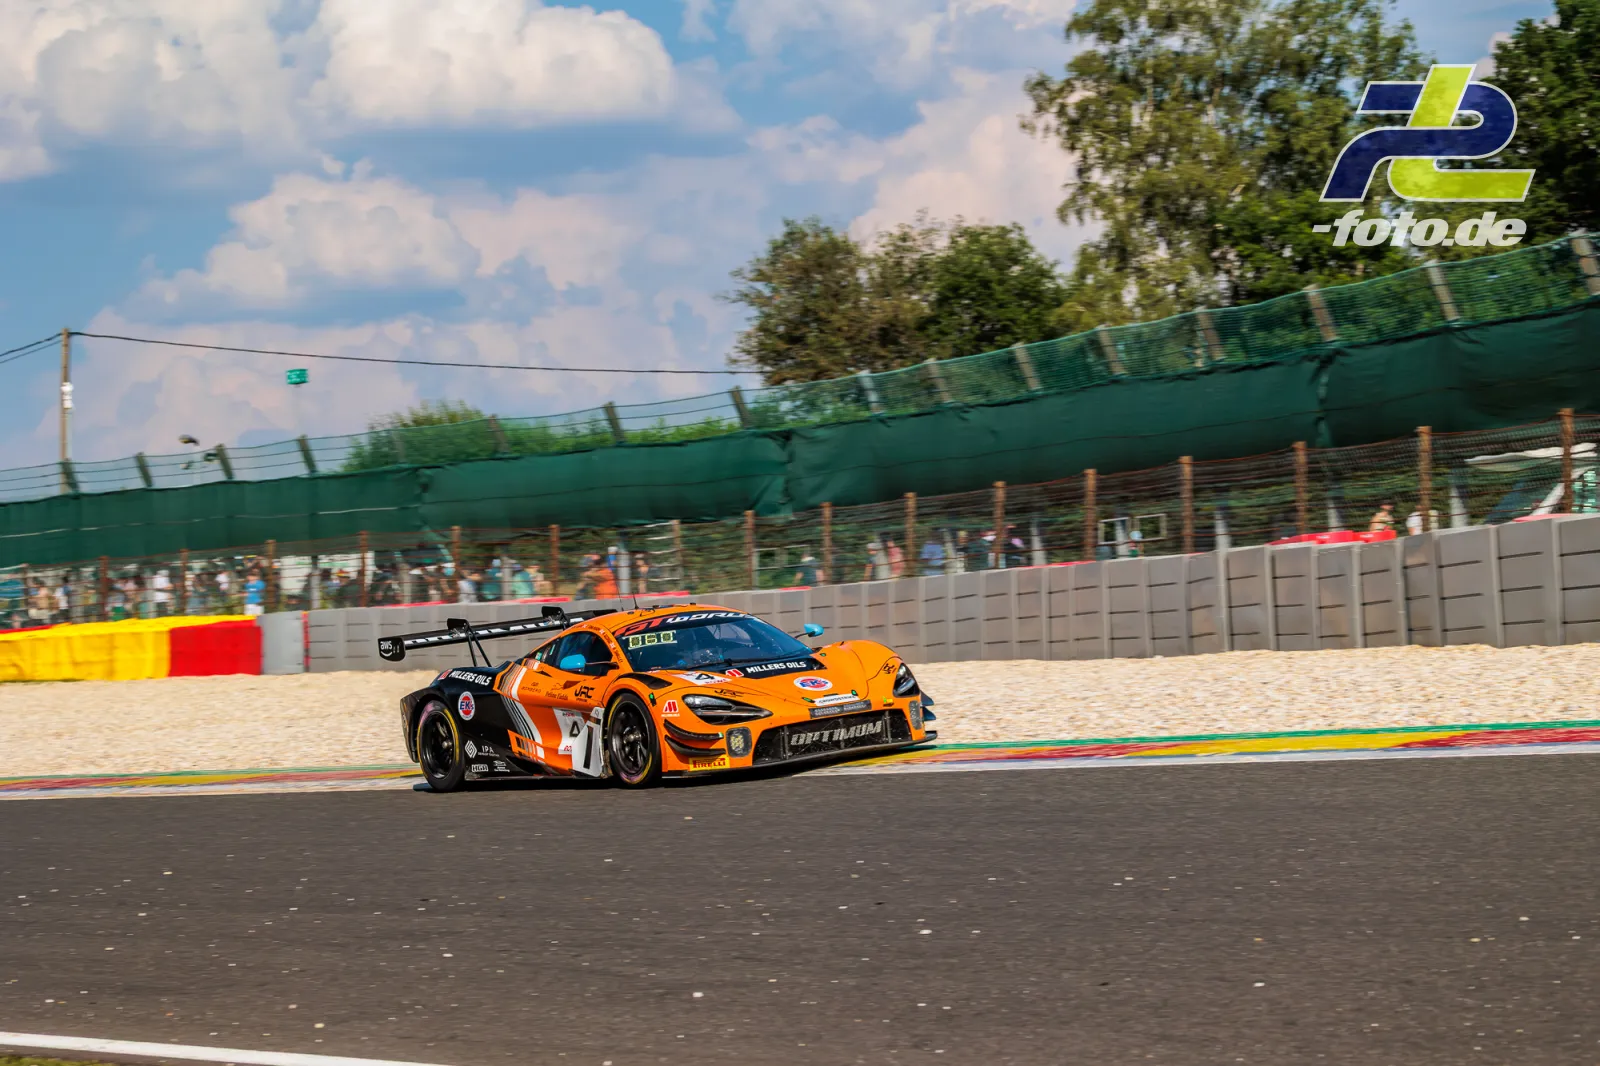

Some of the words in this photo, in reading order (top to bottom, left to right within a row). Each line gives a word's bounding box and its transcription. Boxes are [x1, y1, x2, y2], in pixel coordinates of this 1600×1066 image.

[746, 662, 786, 674] MILLERS
[786, 661, 807, 669] OILS
[449, 670, 478, 682] MILLERS
[474, 675, 493, 686] OILS
[790, 720, 883, 746] OPTIMUM
[692, 757, 726, 768] PIRELLI
